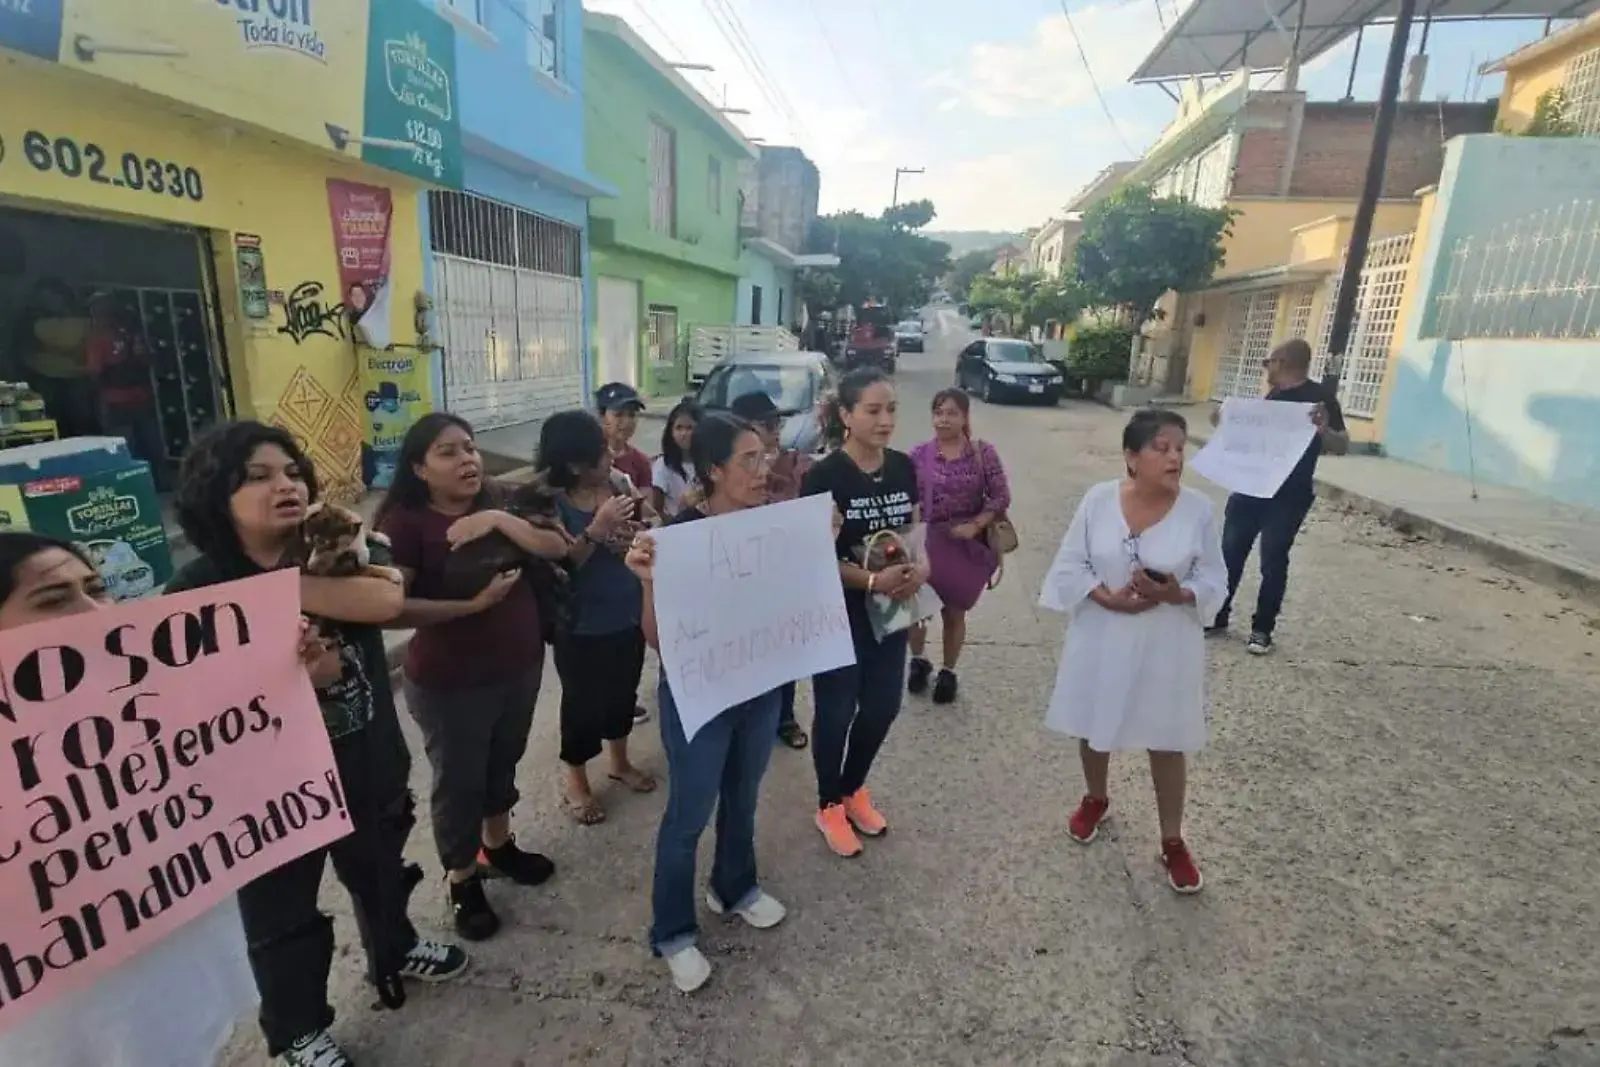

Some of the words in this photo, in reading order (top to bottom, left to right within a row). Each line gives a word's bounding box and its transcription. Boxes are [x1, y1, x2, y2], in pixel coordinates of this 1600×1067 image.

[236, 16, 279, 43] Toda
[297, 30, 325, 57] vida
[846, 508, 862, 520] DE
[0, 769, 349, 1011] bandonados!
[28, 782, 214, 914] perros
